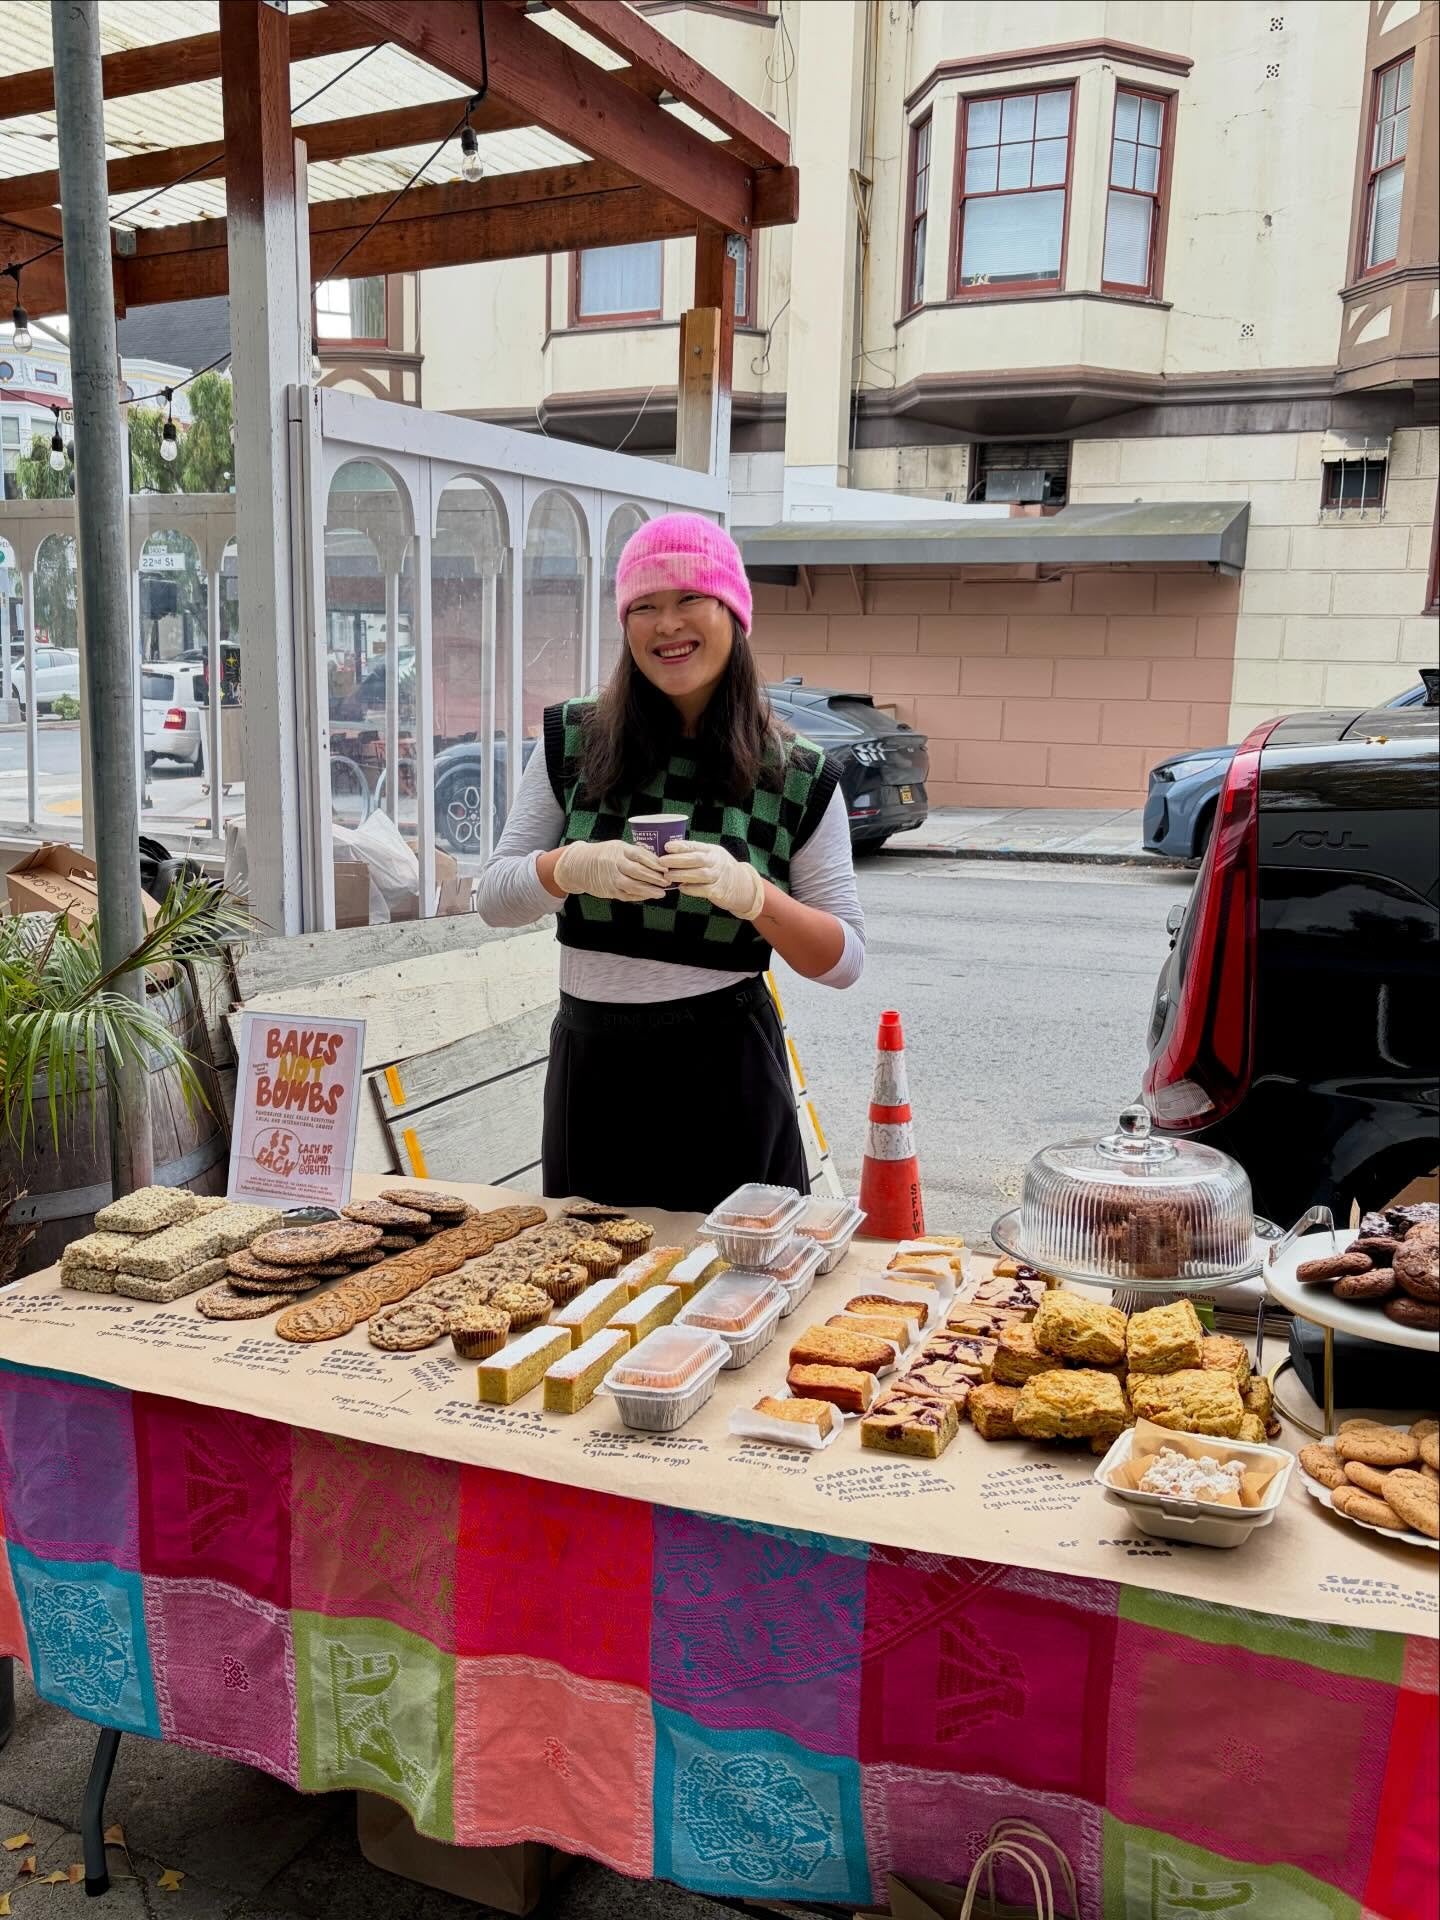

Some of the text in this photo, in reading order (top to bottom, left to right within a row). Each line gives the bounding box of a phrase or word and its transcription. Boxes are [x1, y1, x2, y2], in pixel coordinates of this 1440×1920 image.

[143, 557, 174, 567] 22nd St
[1272, 830, 1368, 849] SOUL
[267, 1028, 343, 1065] BAKES
[278, 1053, 325, 1085] NOT
[256, 1076, 344, 1115] BOMBS
[270, 1130, 293, 1156] $5
[298, 1144, 333, 1154] CASH OR
[256, 1146, 296, 1177] EACH
[302, 1154, 328, 1165] VENMO
[1190, 1293, 1216, 1301] GLOVES
[132, 1320, 201, 1331] BUTTER
[153, 1313, 218, 1325] BROWN
[110, 1324, 172, 1335] SESAME
[236, 1345, 302, 1356] BREAD
[241, 1338, 318, 1350] GINGER
[435, 1357, 462, 1373] APPLE
[408, 1366, 442, 1392] MUFFINS
[422, 1361, 454, 1385] GINGER
[460, 1412, 518, 1426] KARAT
[520, 1423, 562, 1434] CAKE
[589, 1430, 639, 1440] SOUR
[583, 1442, 629, 1451] ROLLS
[651, 1441, 710, 1452] DINNER
[814, 1463, 911, 1482] CARDAMOM
[987, 1463, 1058, 1479] CHEDDAR
[815, 1469, 932, 1492] PARSNIP CAKE
[838, 1482, 911, 1495] AMARENA
[918, 1477, 948, 1487] JAM
[981, 1474, 1064, 1490] BUTTERNUT
[979, 1487, 1038, 1500] SQUASH
[1098, 1539, 1154, 1547] APPLE
[1326, 1575, 1400, 1590] SWEET
